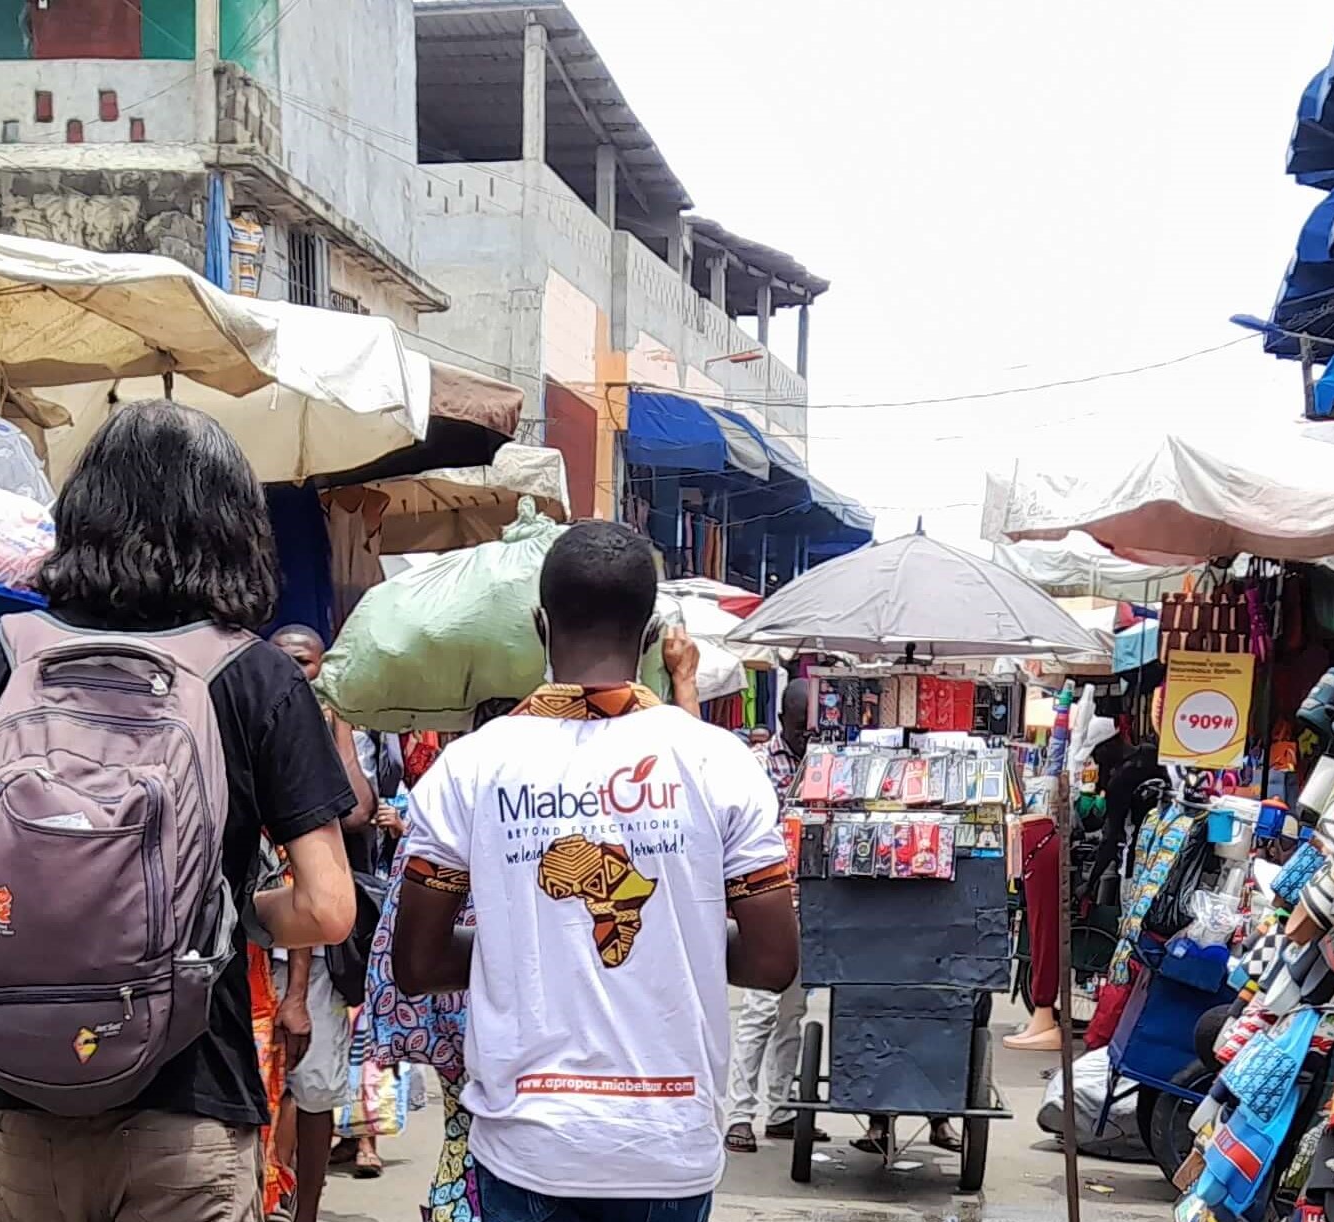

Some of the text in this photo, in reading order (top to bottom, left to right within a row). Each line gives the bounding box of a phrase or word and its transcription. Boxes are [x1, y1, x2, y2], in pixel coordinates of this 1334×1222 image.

[507, 820, 680, 840] BEYOND EXPECTATIONS
[630, 833, 685, 863] forward!
